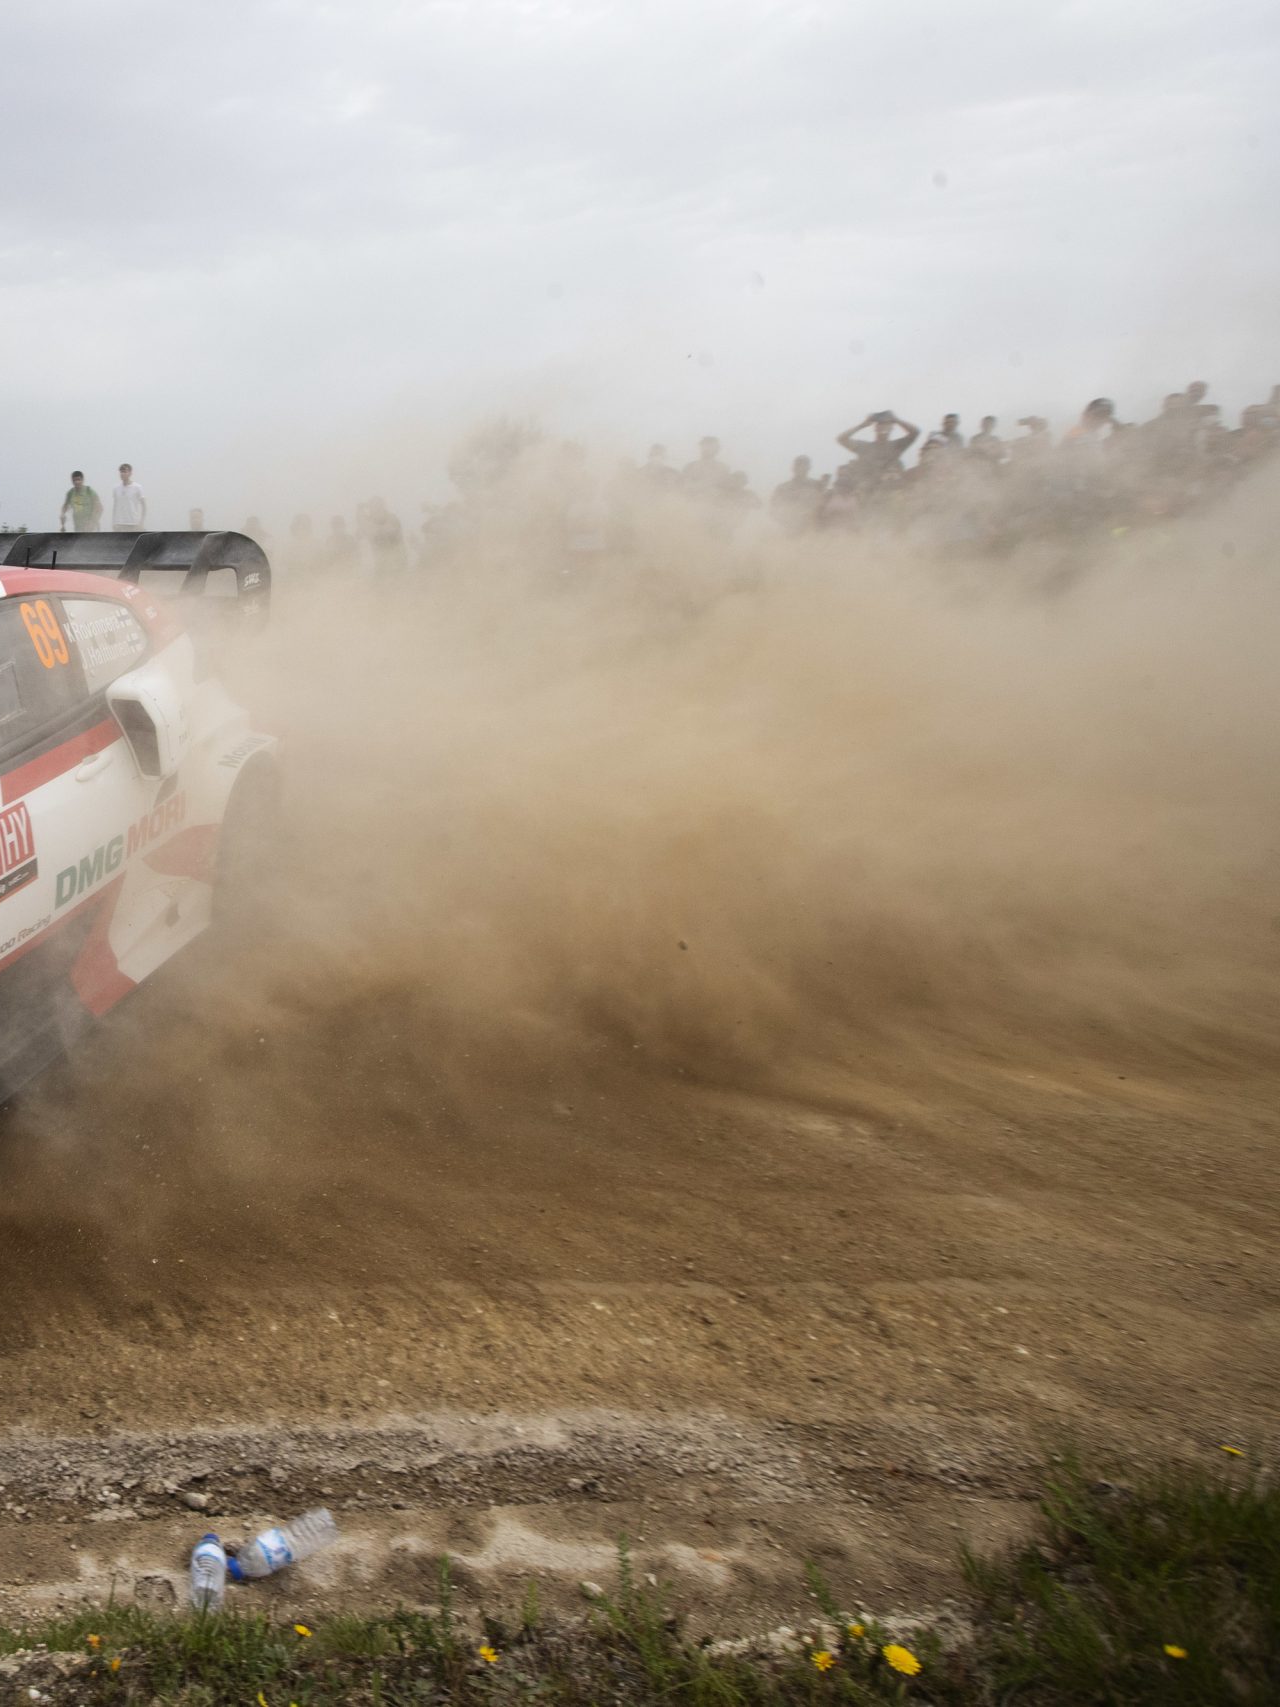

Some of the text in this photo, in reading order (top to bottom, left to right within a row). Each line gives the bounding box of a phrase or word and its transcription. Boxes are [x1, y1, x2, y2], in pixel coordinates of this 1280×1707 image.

[21, 600, 69, 668] 69
[0, 806, 29, 865] HY
[55, 790, 186, 911] DMG MORI
